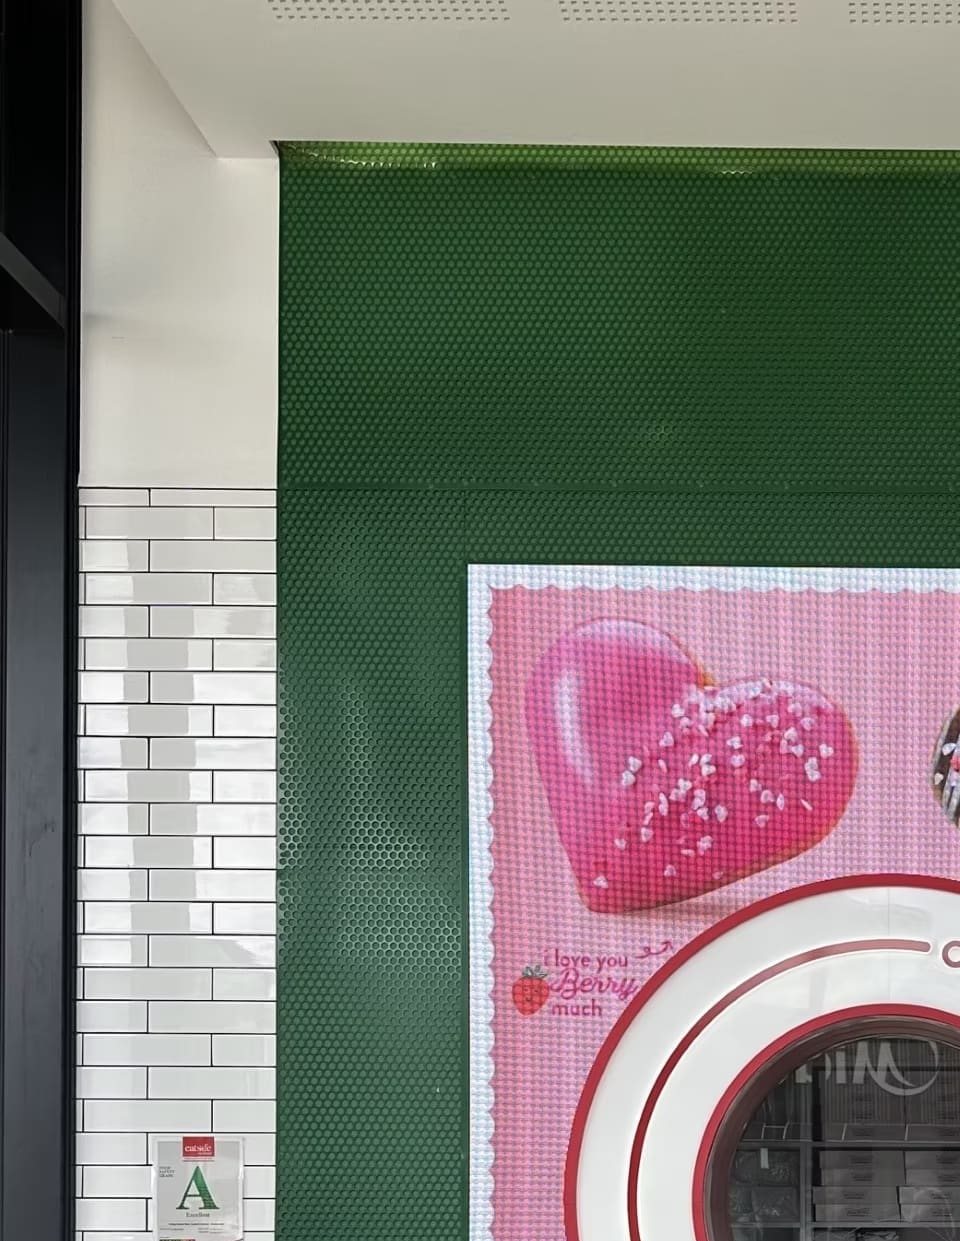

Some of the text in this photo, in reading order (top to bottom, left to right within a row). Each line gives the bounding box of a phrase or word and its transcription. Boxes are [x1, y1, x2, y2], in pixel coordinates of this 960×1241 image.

[555, 949, 591, 967] love
[596, 955, 628, 973] you
[550, 967, 640, 1000] Berry
[552, 999, 602, 1016] much
[176, 1165, 220, 1210] A
